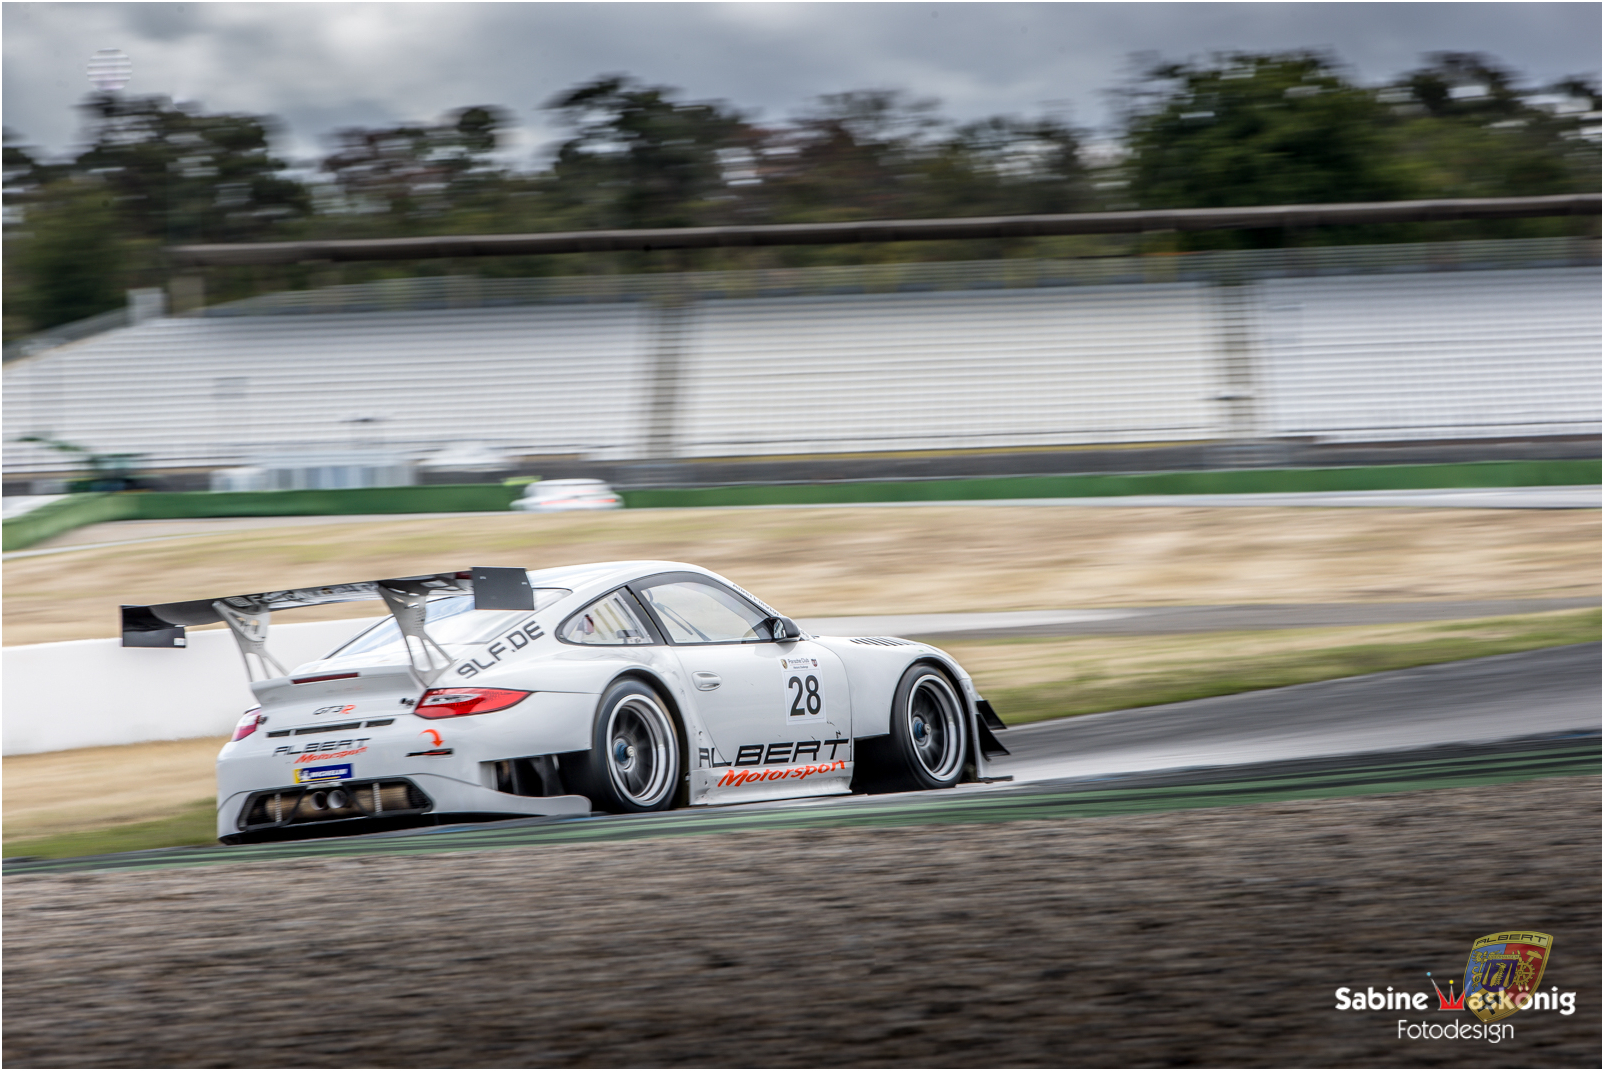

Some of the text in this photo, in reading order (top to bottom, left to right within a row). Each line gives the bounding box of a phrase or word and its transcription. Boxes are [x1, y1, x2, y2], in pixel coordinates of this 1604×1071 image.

[457, 620, 545, 679] 9LF.DE
[788, 674, 821, 716] 28
[272, 738, 371, 757] ALBERT
[293, 746, 369, 764] Motorsport
[699, 738, 849, 768] ALBERT
[717, 759, 846, 787] Motorsport
